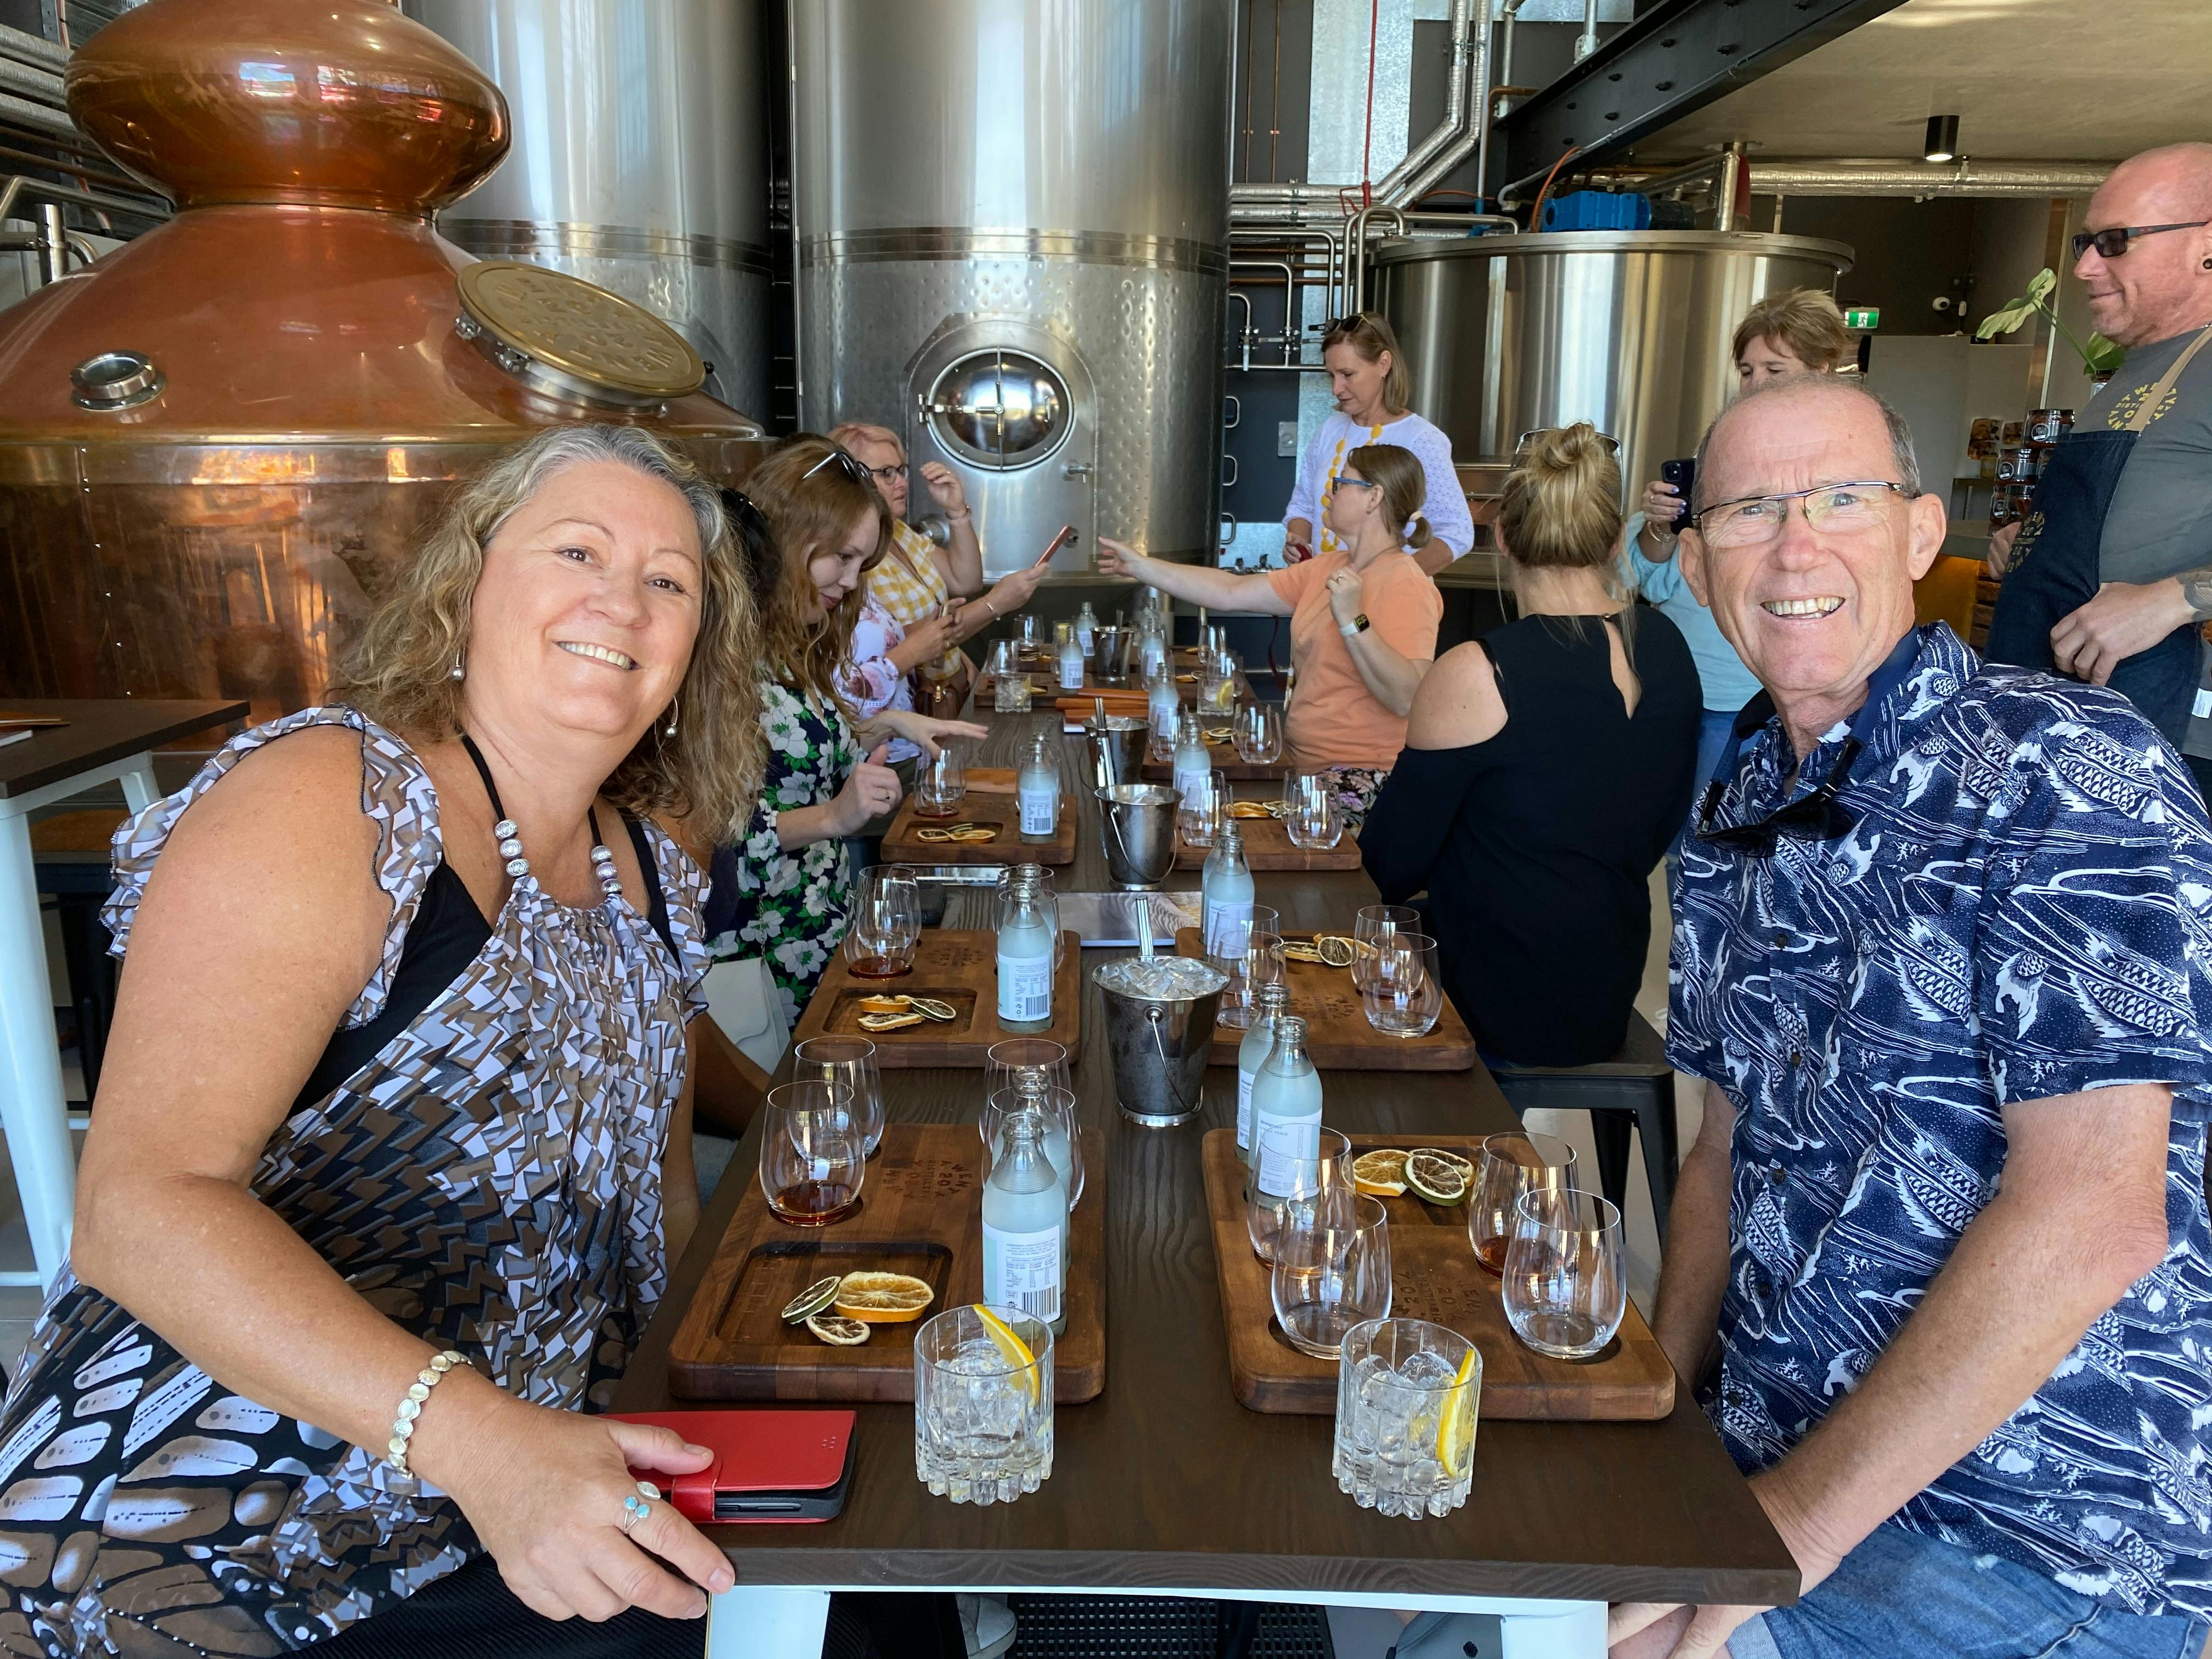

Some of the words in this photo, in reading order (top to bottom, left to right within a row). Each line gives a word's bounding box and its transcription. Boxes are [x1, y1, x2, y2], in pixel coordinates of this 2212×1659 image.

[2122, 382, 2177, 404] TWTY
[2115, 403, 2172, 411] DISTIRY
[934, 1160, 973, 1198] TWENTY
[937, 1172, 953, 1186] 20
[1400, 1286, 1419, 1304] 20
